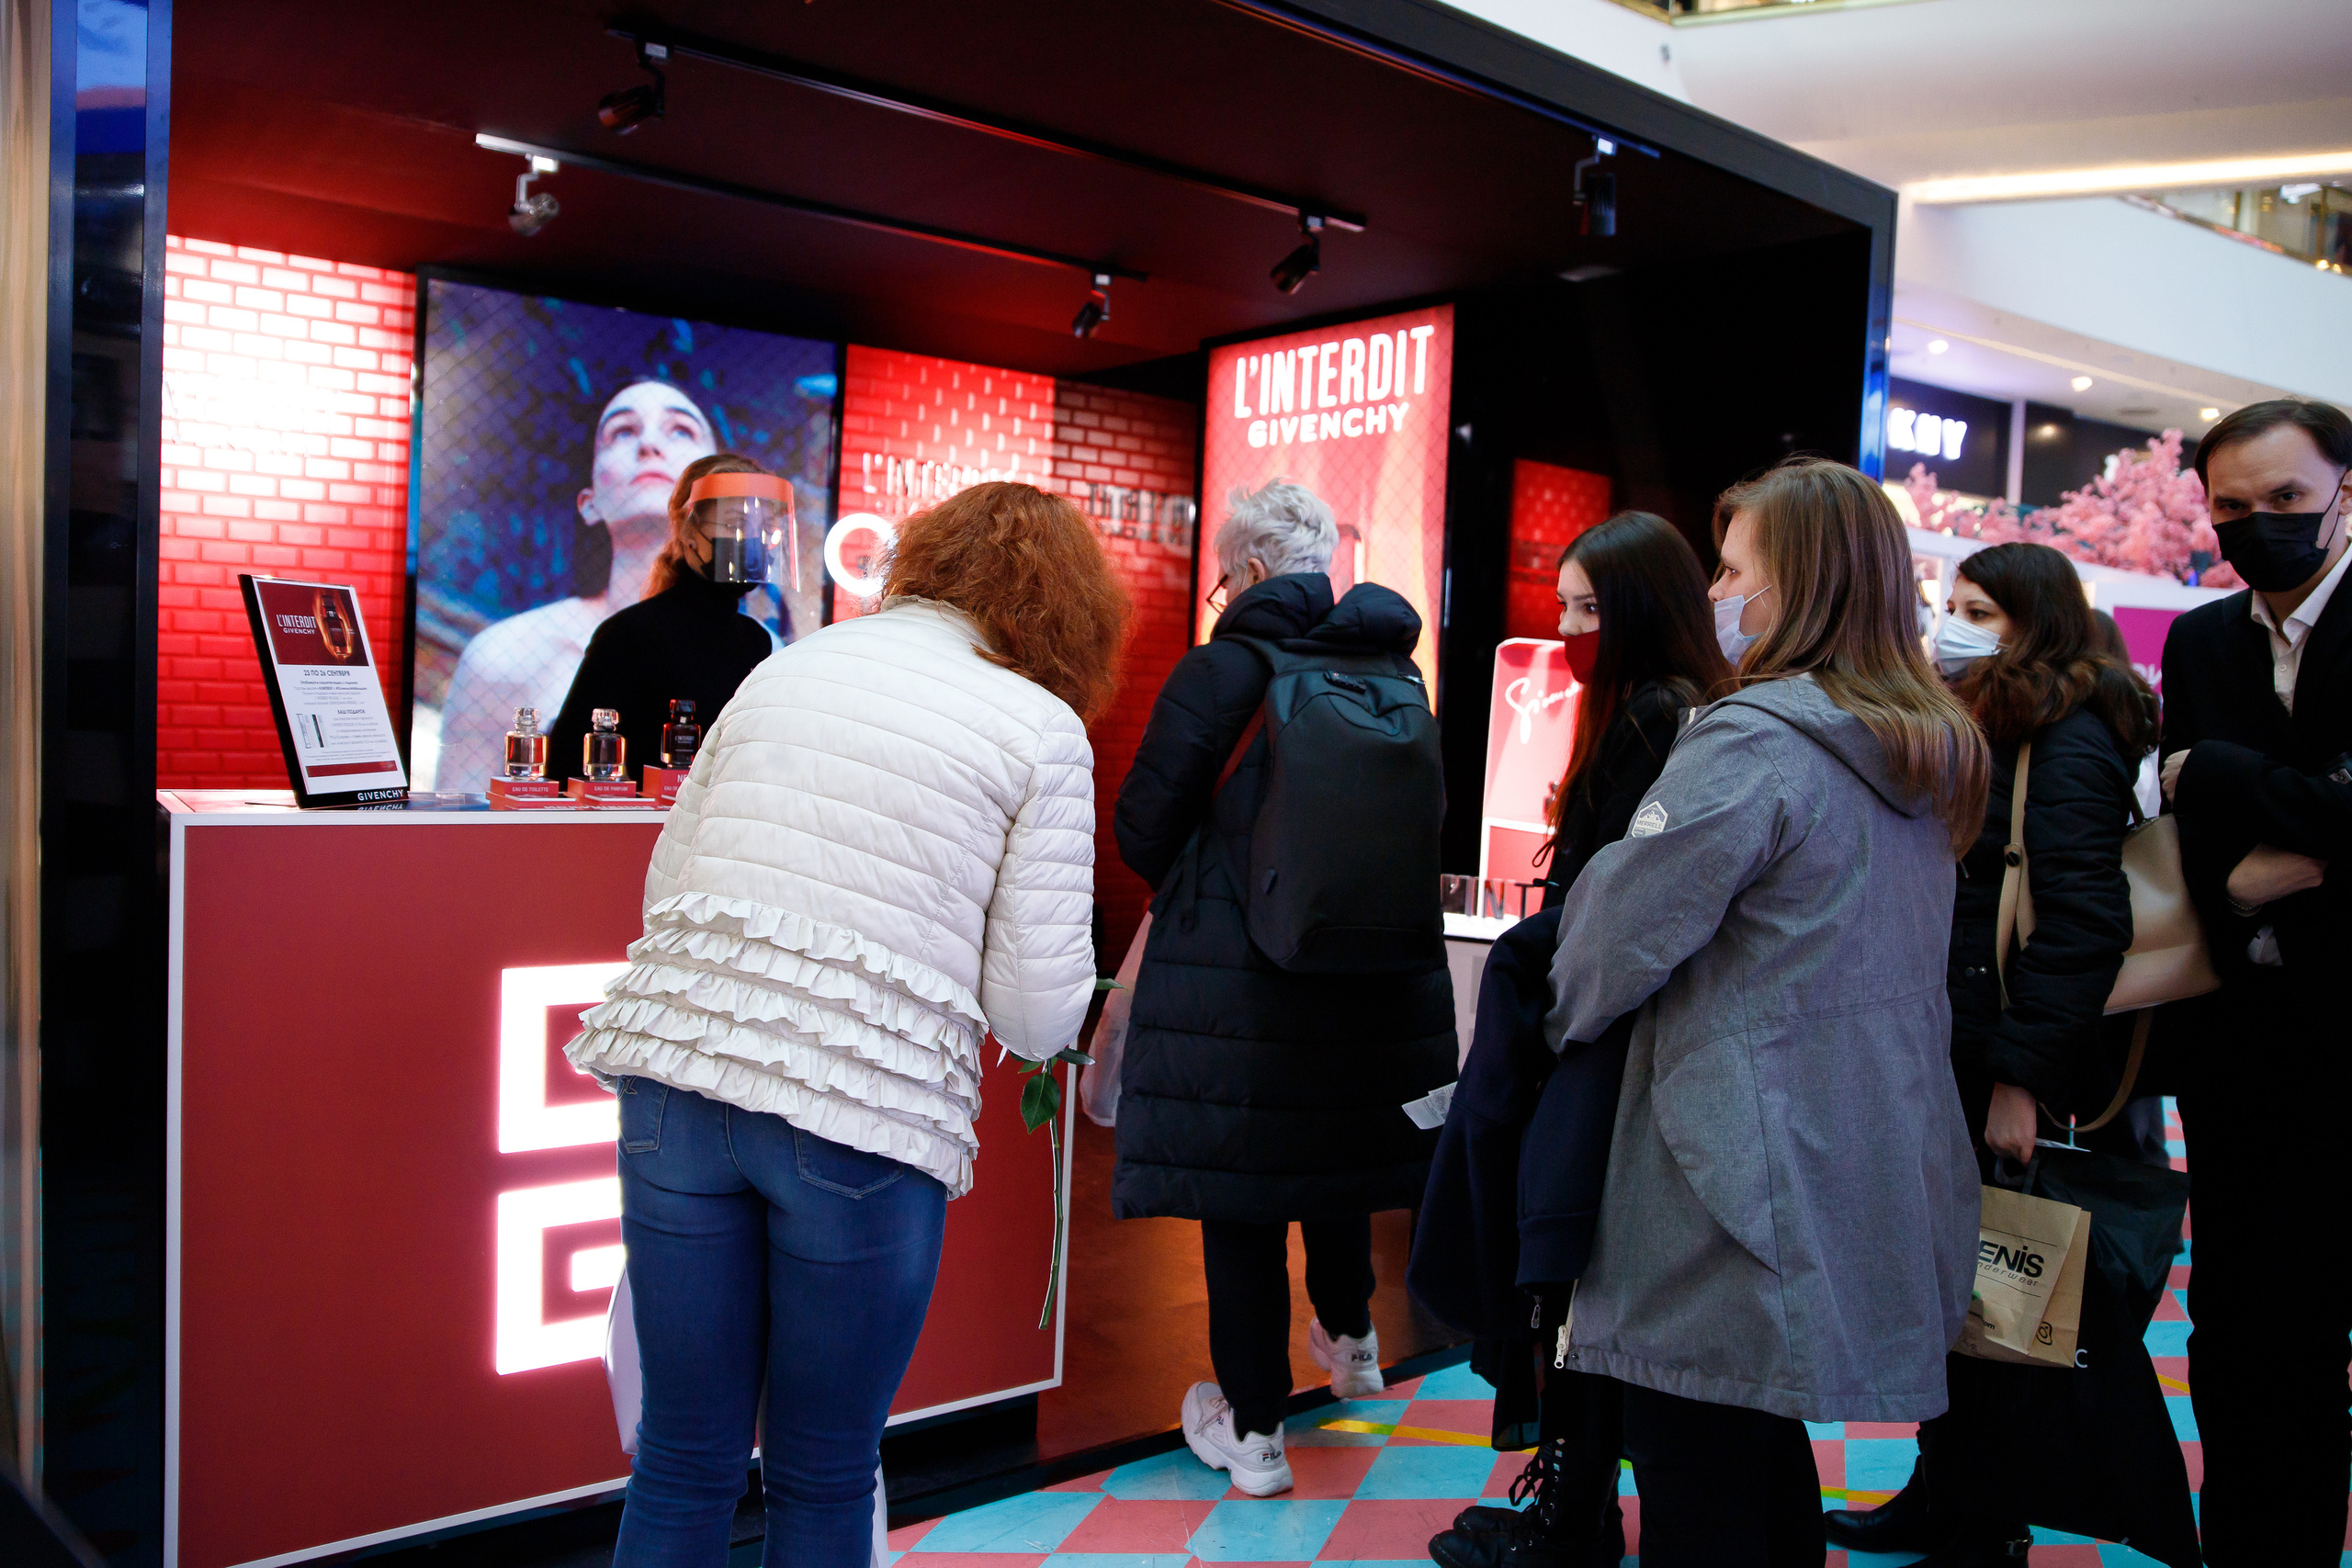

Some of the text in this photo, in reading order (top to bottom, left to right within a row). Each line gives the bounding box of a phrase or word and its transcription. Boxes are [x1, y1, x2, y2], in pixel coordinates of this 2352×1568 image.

[1235, 325, 1434, 418] L'INTERDIT
[1248, 402, 1409, 448] GIVENCHY
[276, 614, 317, 628] L'INTERDIT
[357, 789, 403, 801] GIVENCHY
[1636, 819, 1662, 829] MERRELL
[1977, 1262, 2040, 1287] nderwear
[1351, 1353, 1372, 1362] FILA
[1261, 1450, 1283, 1462] FILA
